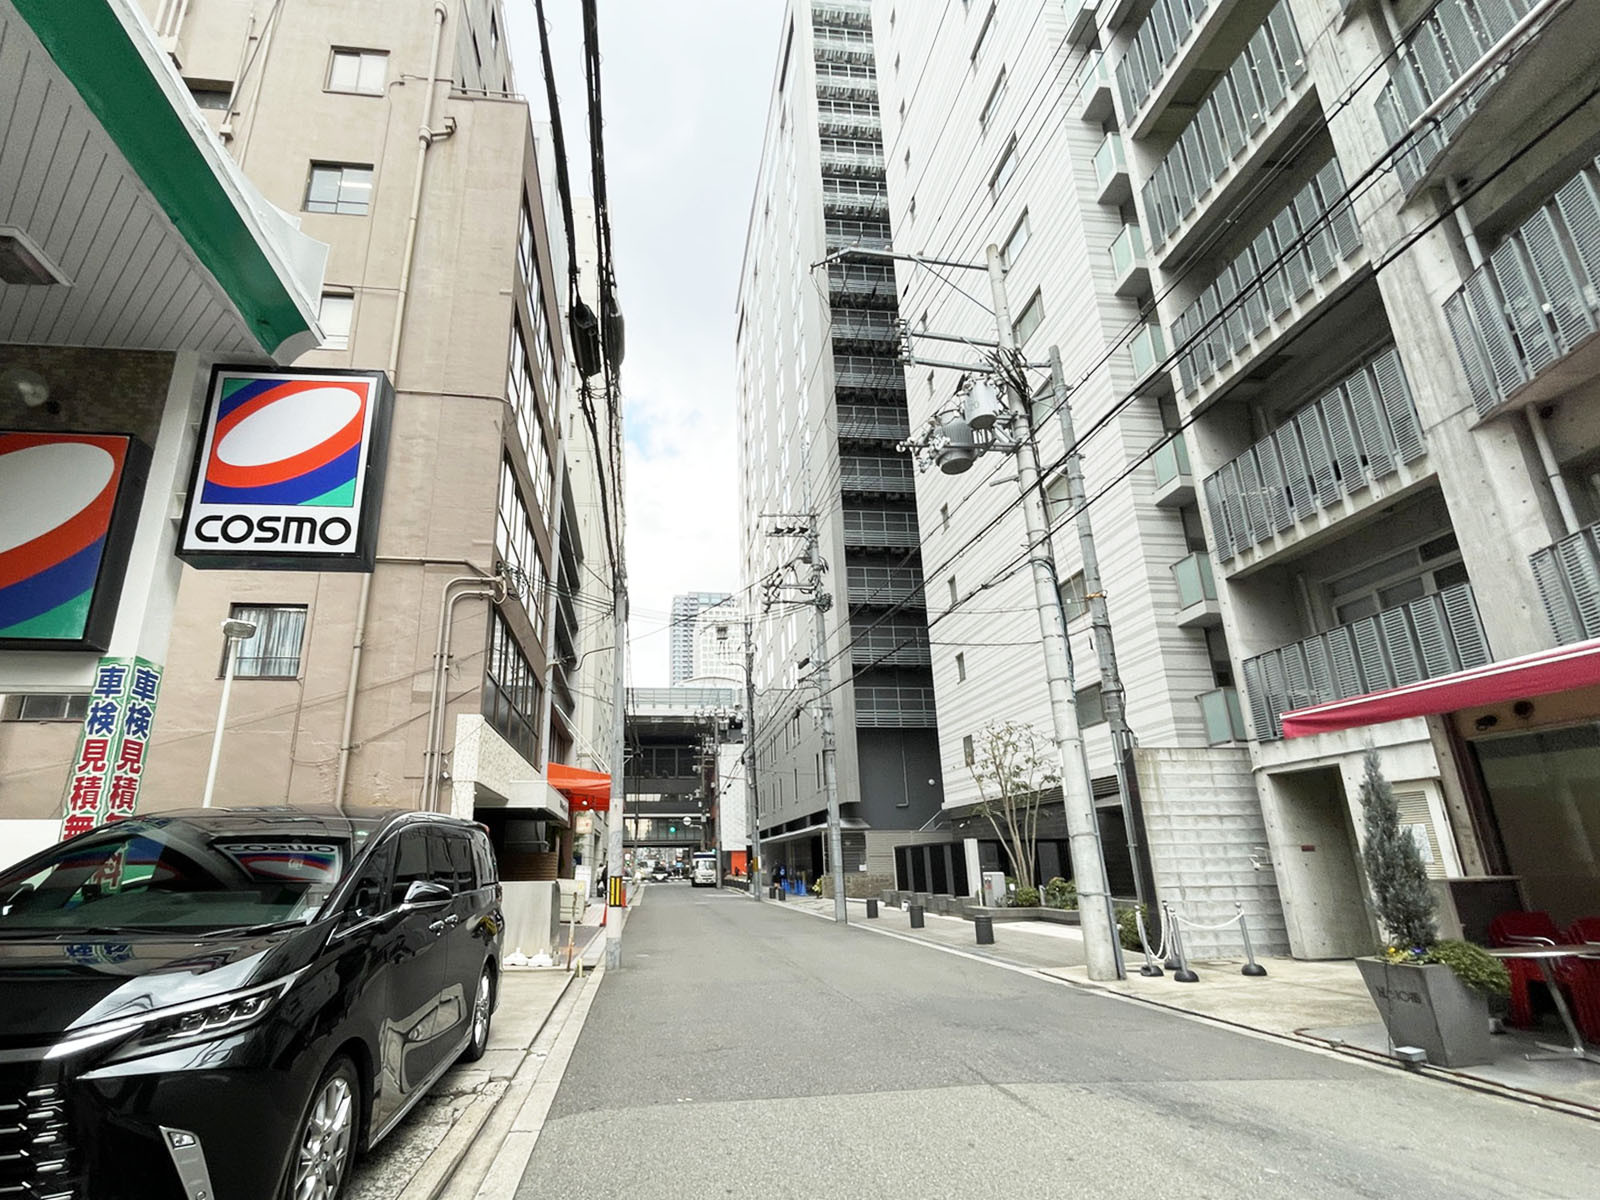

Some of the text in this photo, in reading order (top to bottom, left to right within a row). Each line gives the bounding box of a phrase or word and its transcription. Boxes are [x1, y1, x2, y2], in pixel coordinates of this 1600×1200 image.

[195, 514, 352, 546] COSMO
[105, 668, 159, 824] 車検見積
